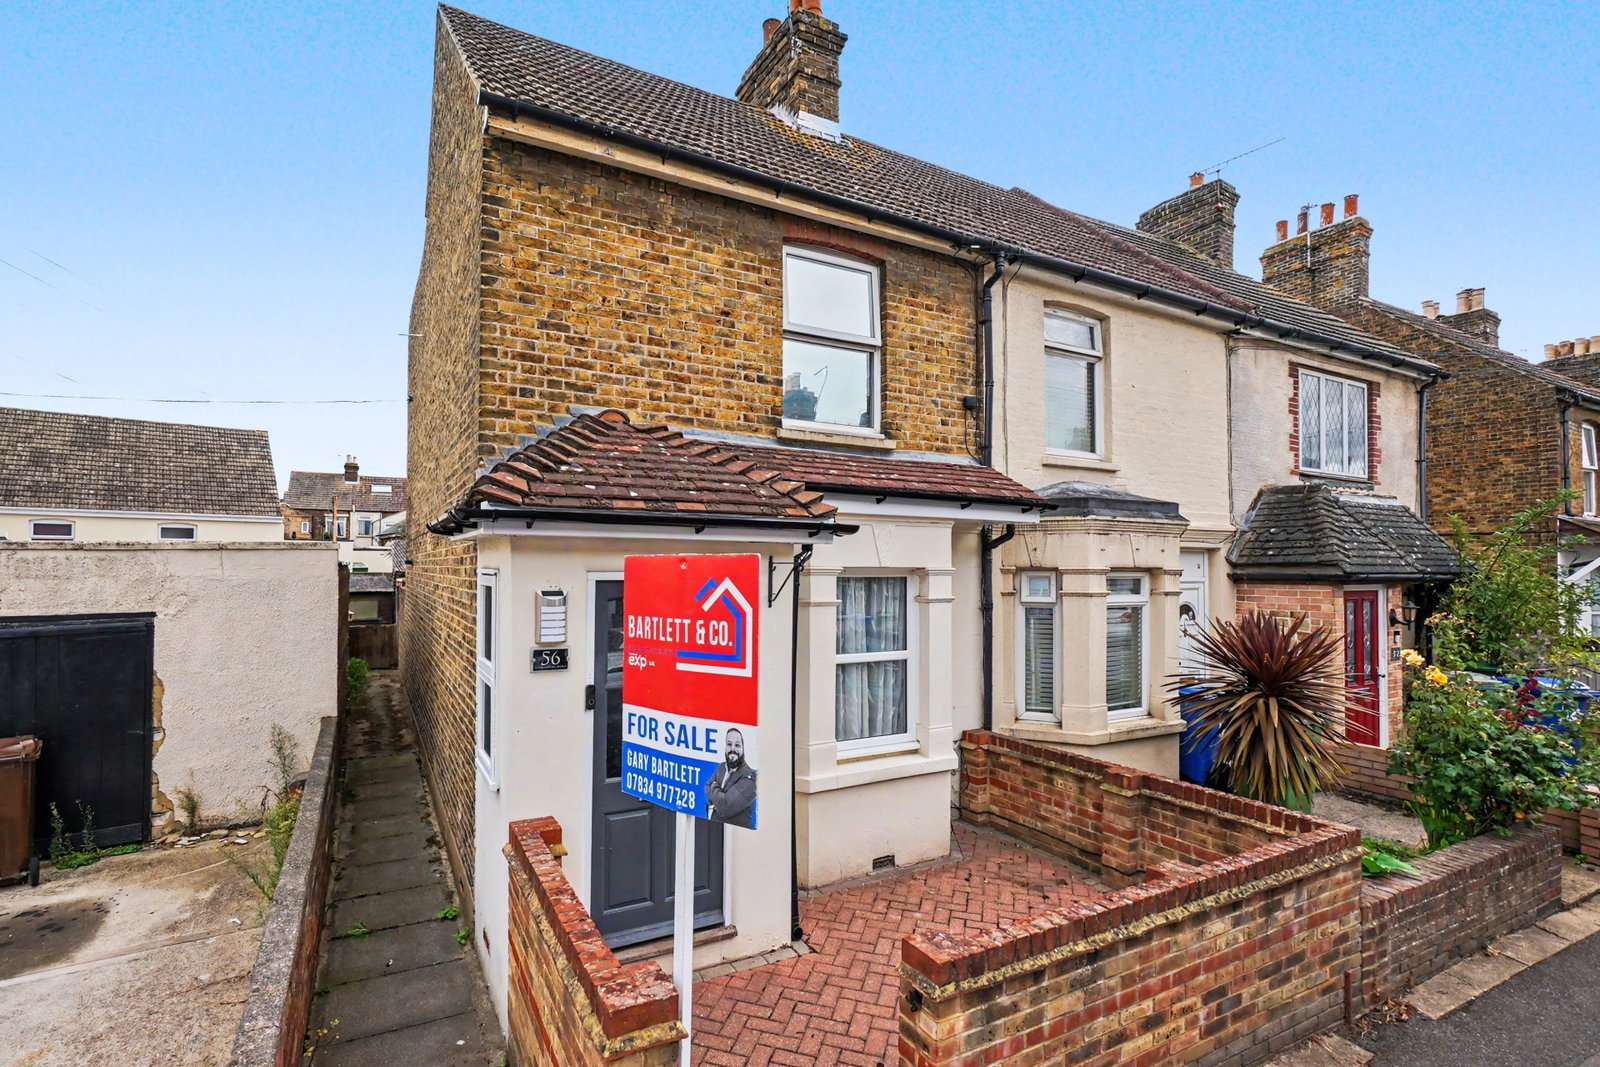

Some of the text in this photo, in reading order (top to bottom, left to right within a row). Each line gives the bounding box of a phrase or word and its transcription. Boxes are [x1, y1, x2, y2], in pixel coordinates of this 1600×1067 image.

[628, 615, 733, 647] BARTLETT & CO.
[541, 650, 561, 666] 56
[627, 712, 718, 754] FOR SALE
[626, 748, 701, 786] GARY BARTLETT
[626, 772, 697, 810] 07834 977728
